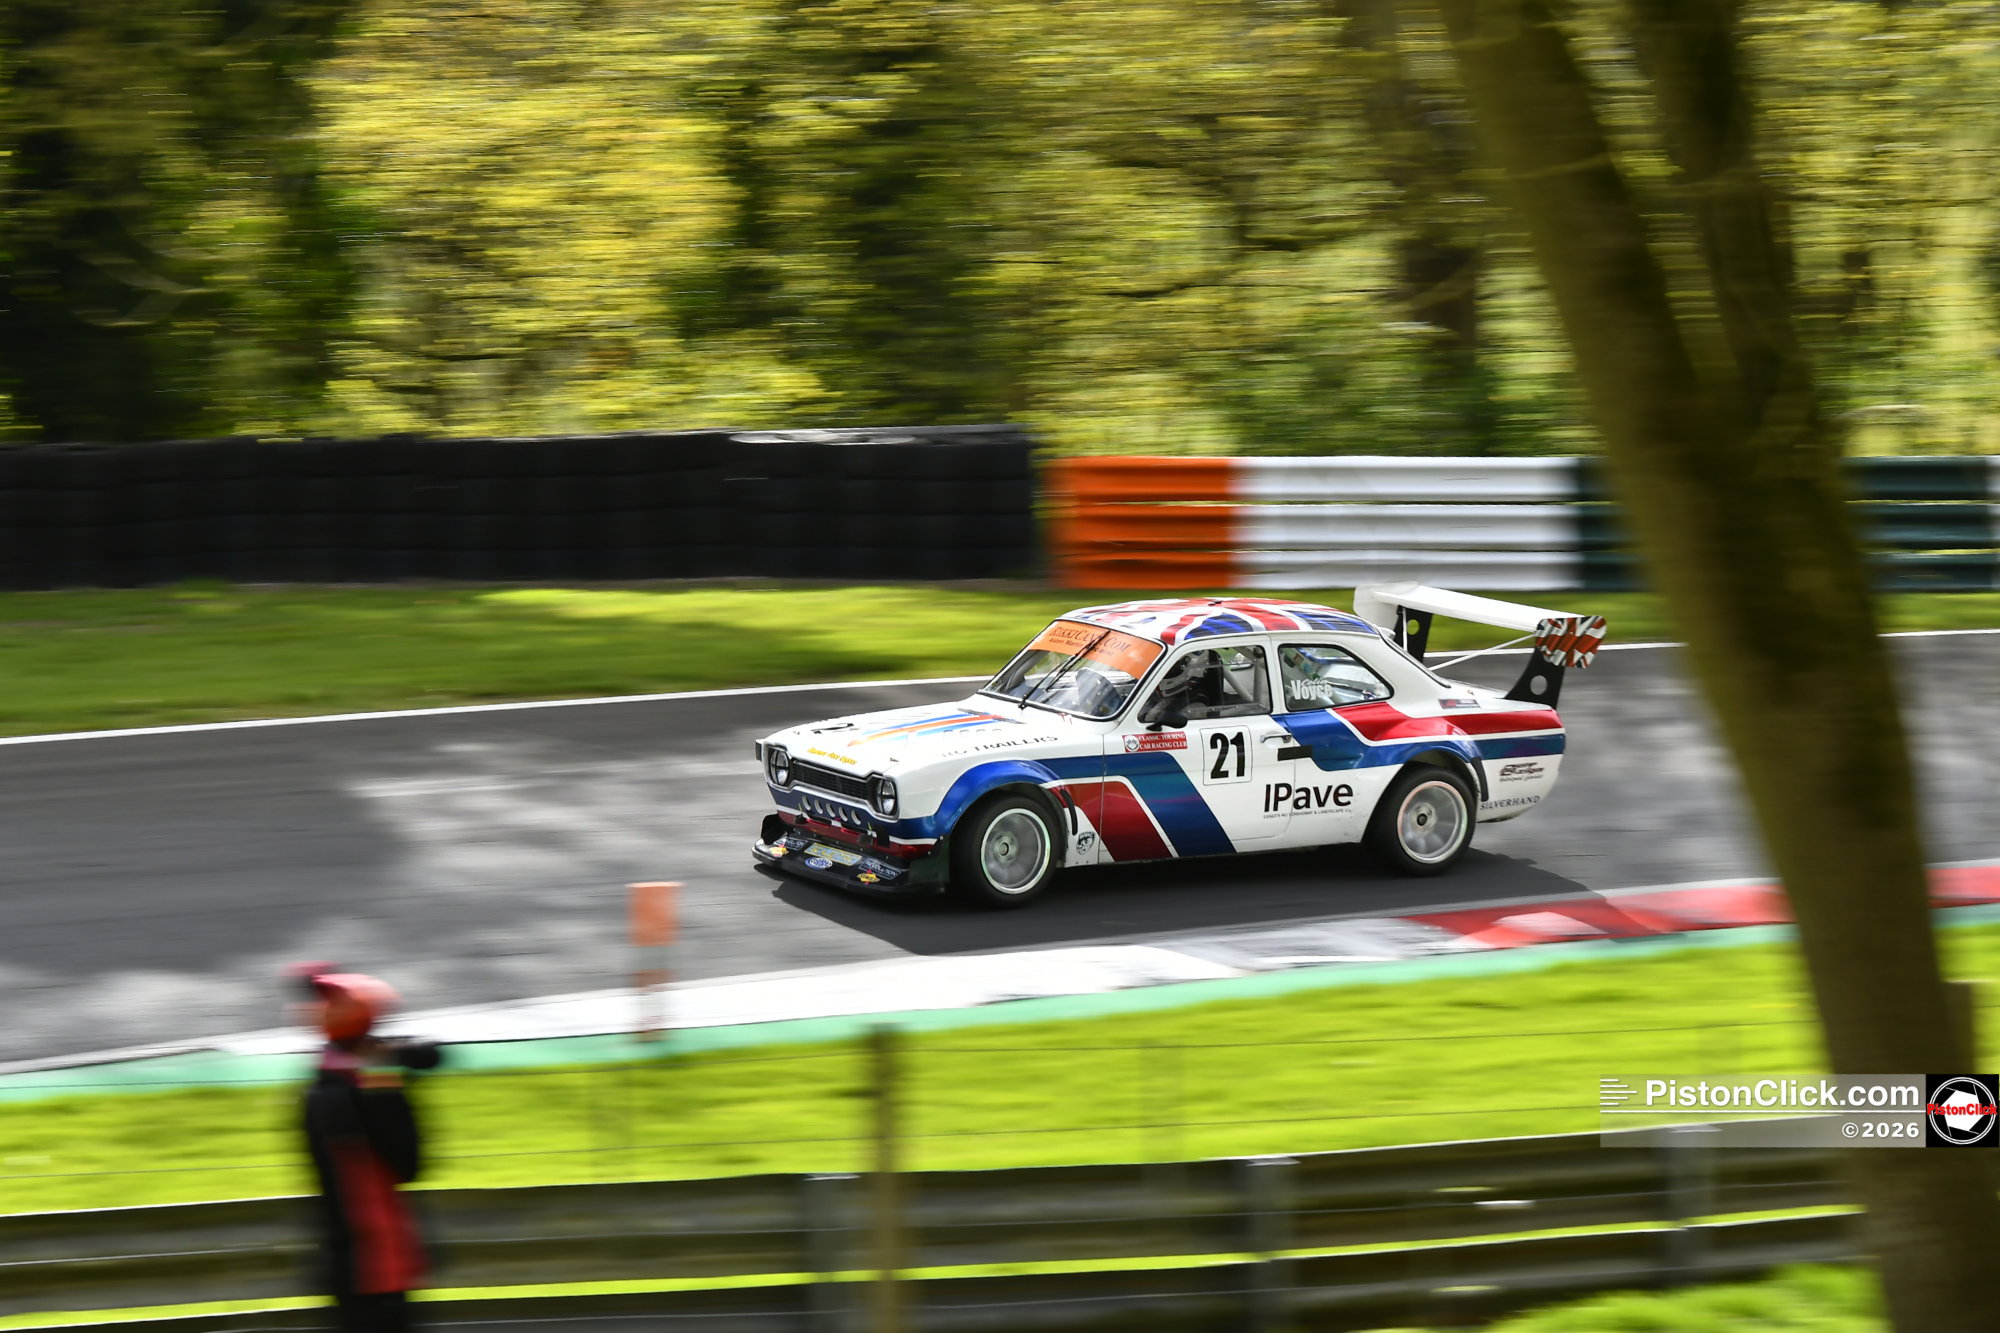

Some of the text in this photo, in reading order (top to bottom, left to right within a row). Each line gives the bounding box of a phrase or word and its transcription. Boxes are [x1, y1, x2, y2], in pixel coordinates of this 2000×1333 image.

[1290, 680, 1333, 701] Voyce
[1138, 732, 1186, 742] CLASSIC TOURING
[1139, 742, 1151, 750] CAR
[1209, 731, 1246, 780] 21
[1263, 782, 1354, 813] IPave
[1480, 795, 1540, 811] SILVERHAND
